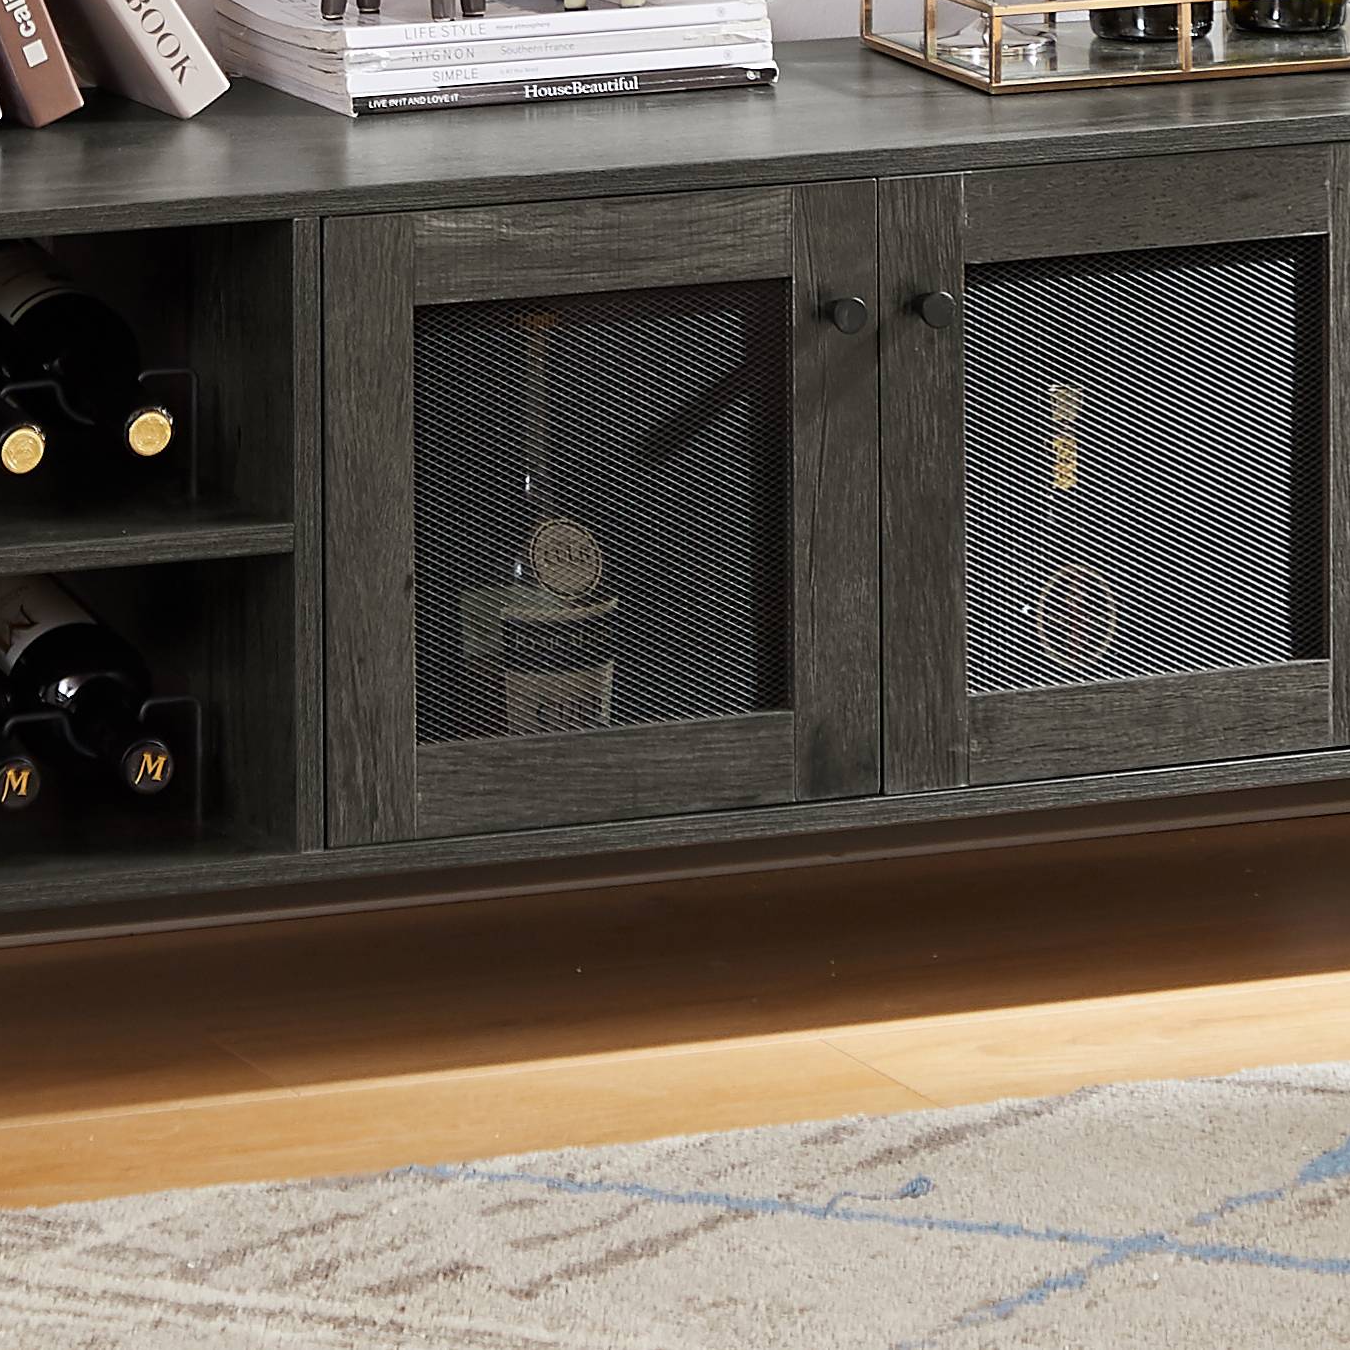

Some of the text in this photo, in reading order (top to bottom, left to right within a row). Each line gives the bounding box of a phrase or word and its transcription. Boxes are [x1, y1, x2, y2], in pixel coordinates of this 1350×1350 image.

[411, 47, 475, 62] MIGNON
[500, 41, 576, 55] Southern France
[432, 67, 479, 82] SIMPLE
[523, 76, 639, 99] HouseBeautiful
[368, 99, 388, 109] LIVE
[427, 95, 450, 104] LOVE
[134, 752, 168, 785] M
[0, 768, 30, 802] M
